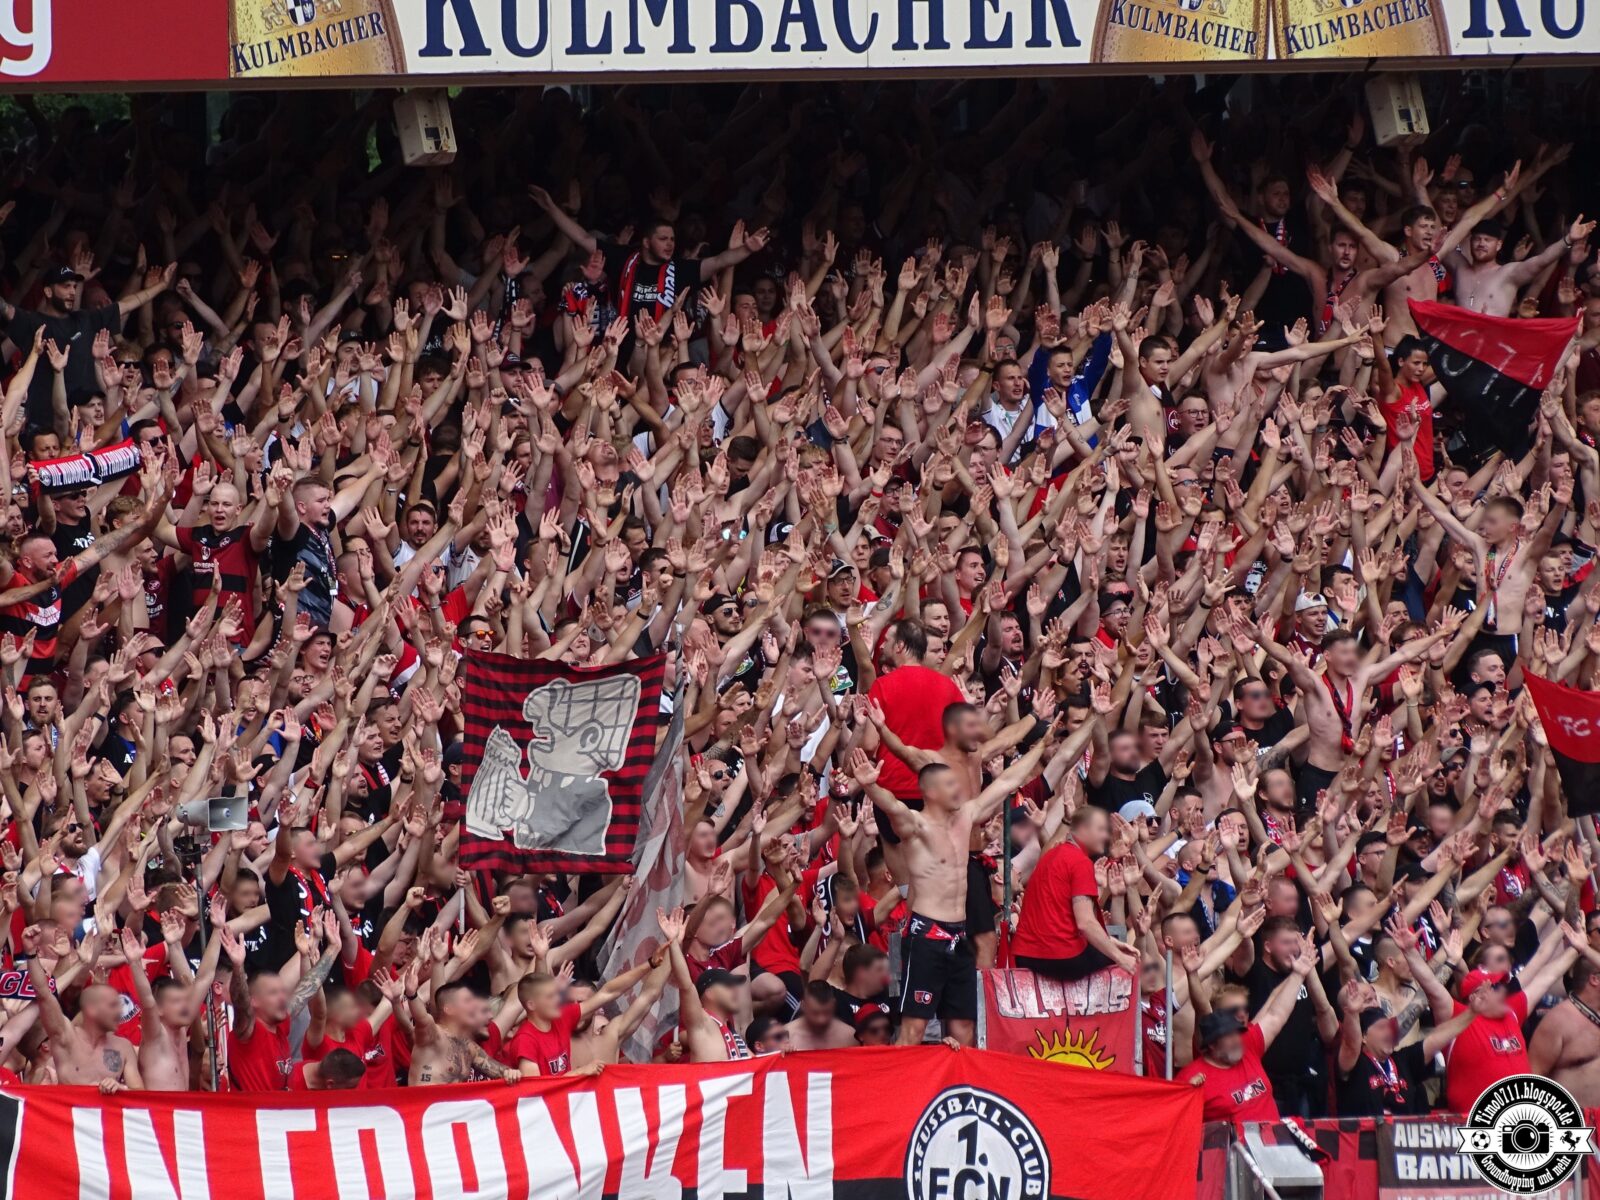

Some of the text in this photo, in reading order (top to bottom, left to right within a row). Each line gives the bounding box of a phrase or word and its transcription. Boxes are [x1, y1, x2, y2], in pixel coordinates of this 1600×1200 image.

[231, 11, 385, 73] KULMBACHER
[1108, 0, 1257, 54] KULMBACHER
[1284, 0, 1432, 55] KULMBACHER
[929, 1167, 1011, 1200] FCN
